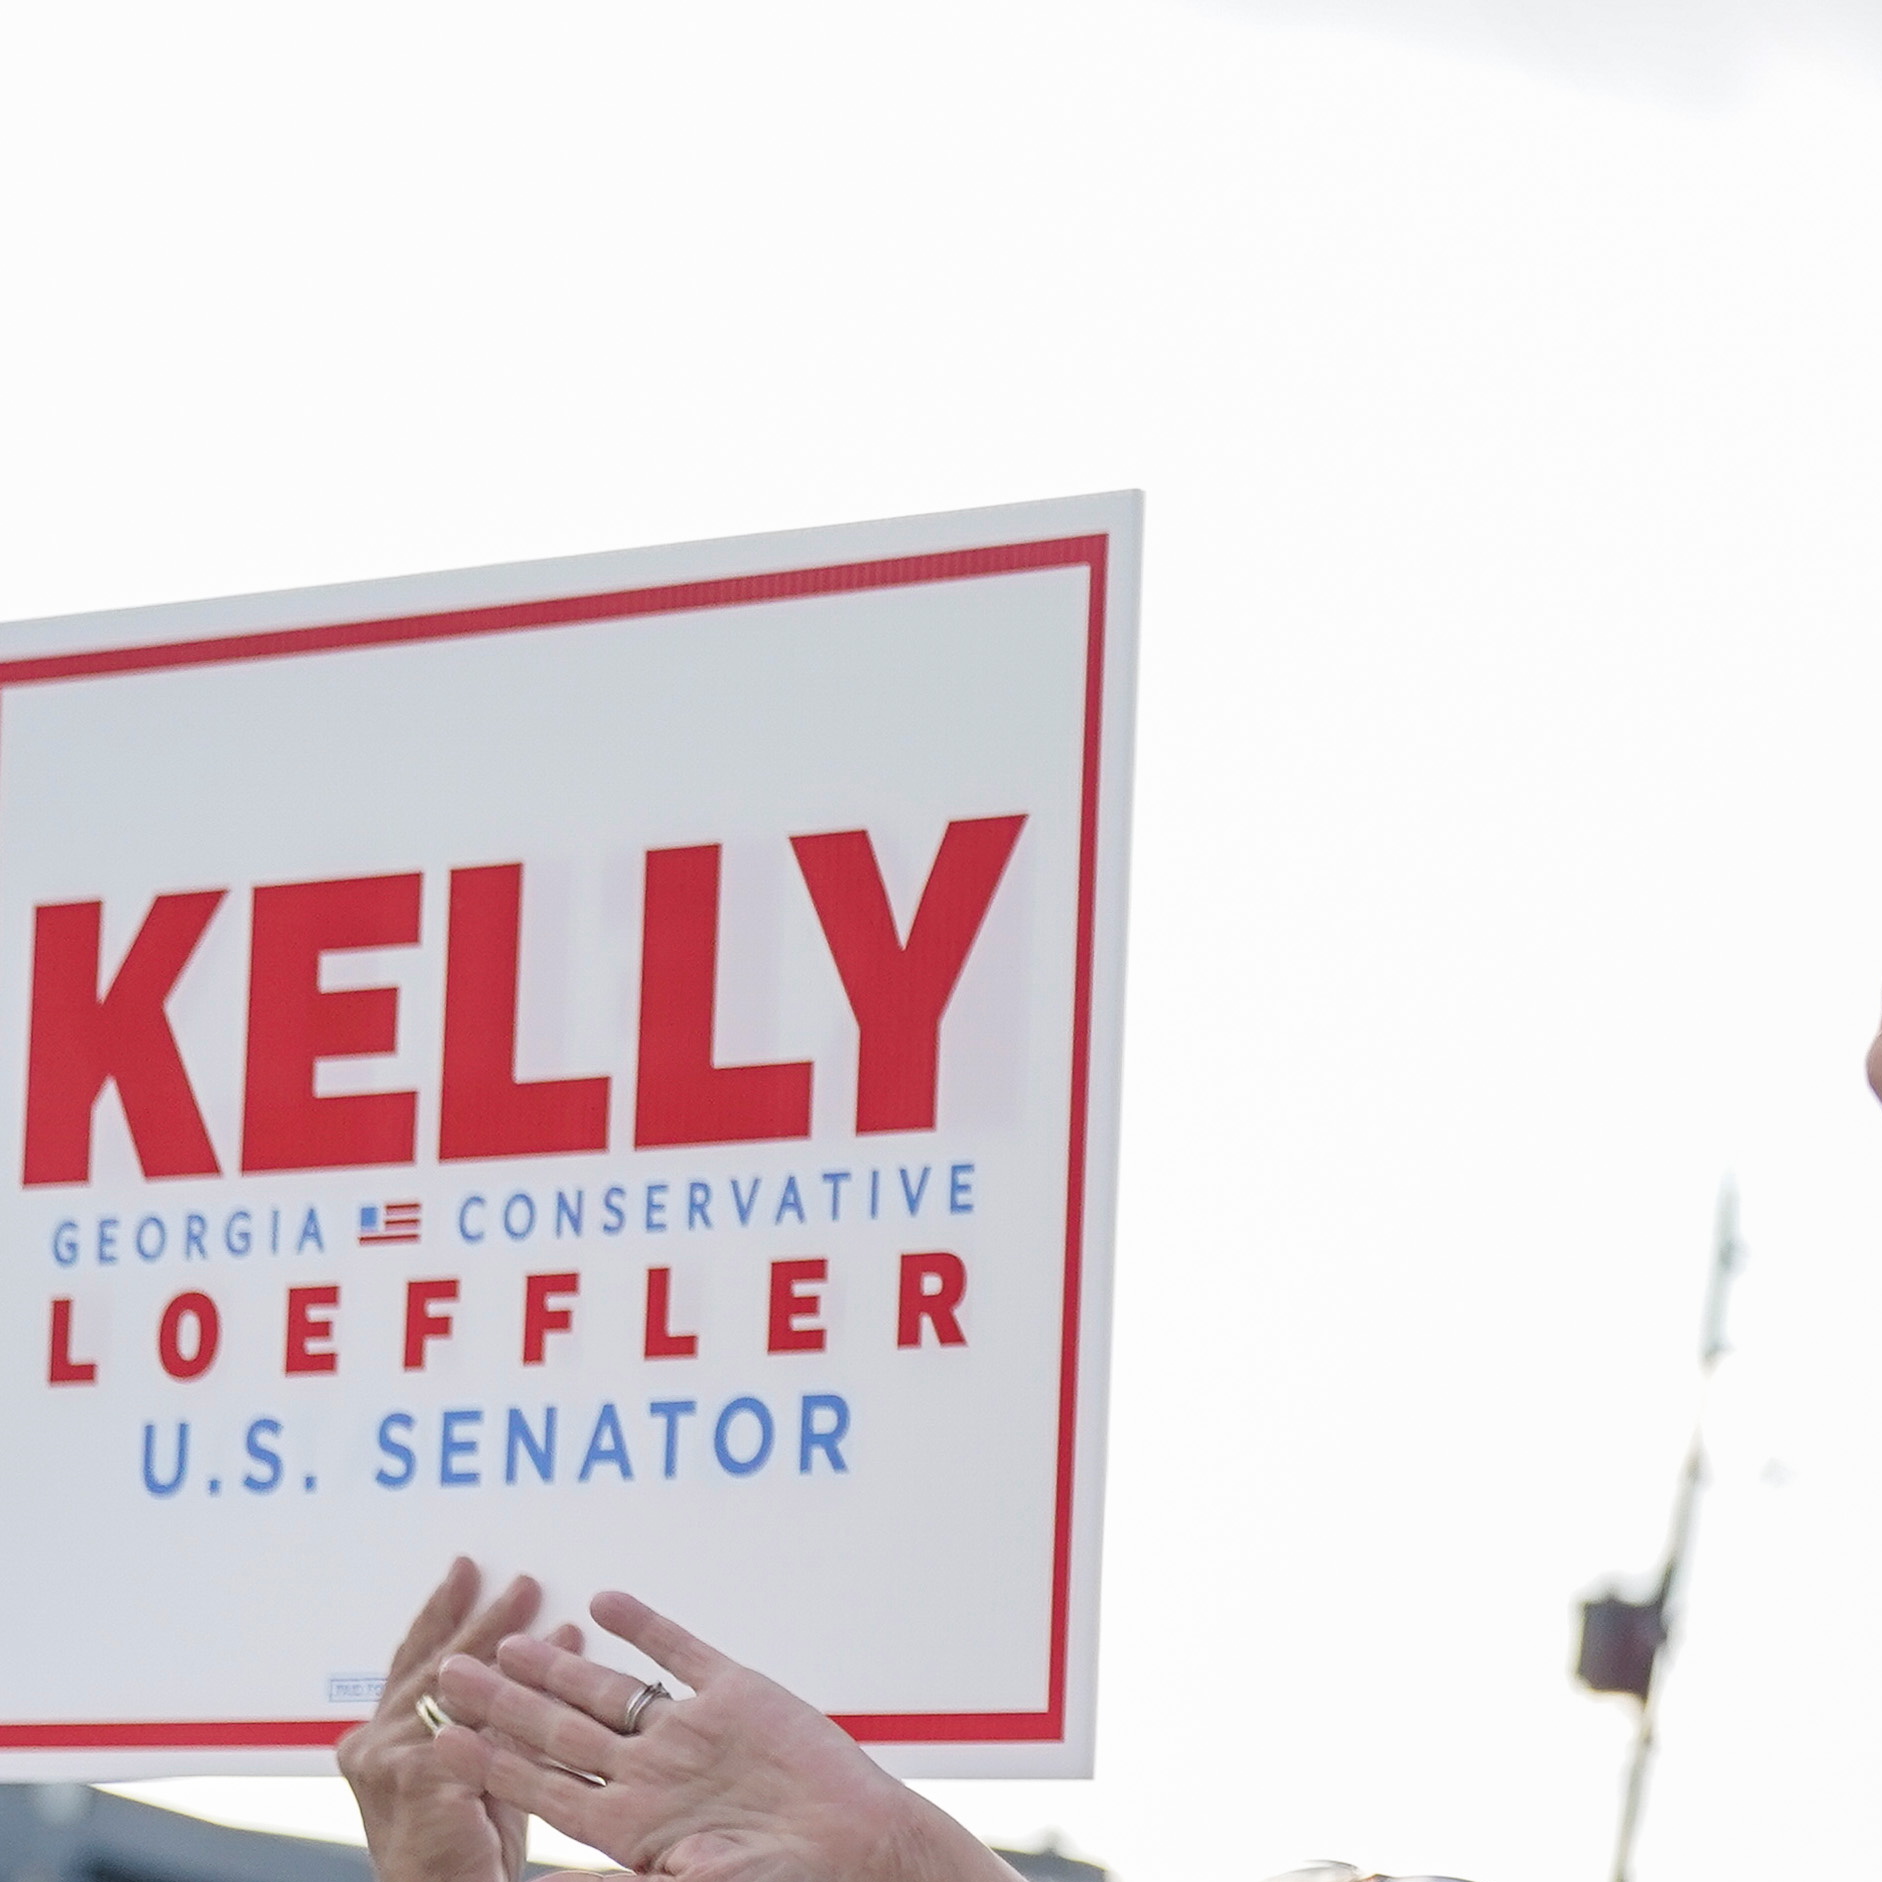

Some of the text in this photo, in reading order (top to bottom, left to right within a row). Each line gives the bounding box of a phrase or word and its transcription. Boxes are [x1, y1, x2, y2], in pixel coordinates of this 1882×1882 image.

[22, 812, 1028, 1187] KELLY
[50, 1160, 977, 1268] GEORGIA CONSERVATIVE
[48, 1252, 968, 1386] LOEFFLER
[140, 1391, 853, 1499] U.S. SENATOR
